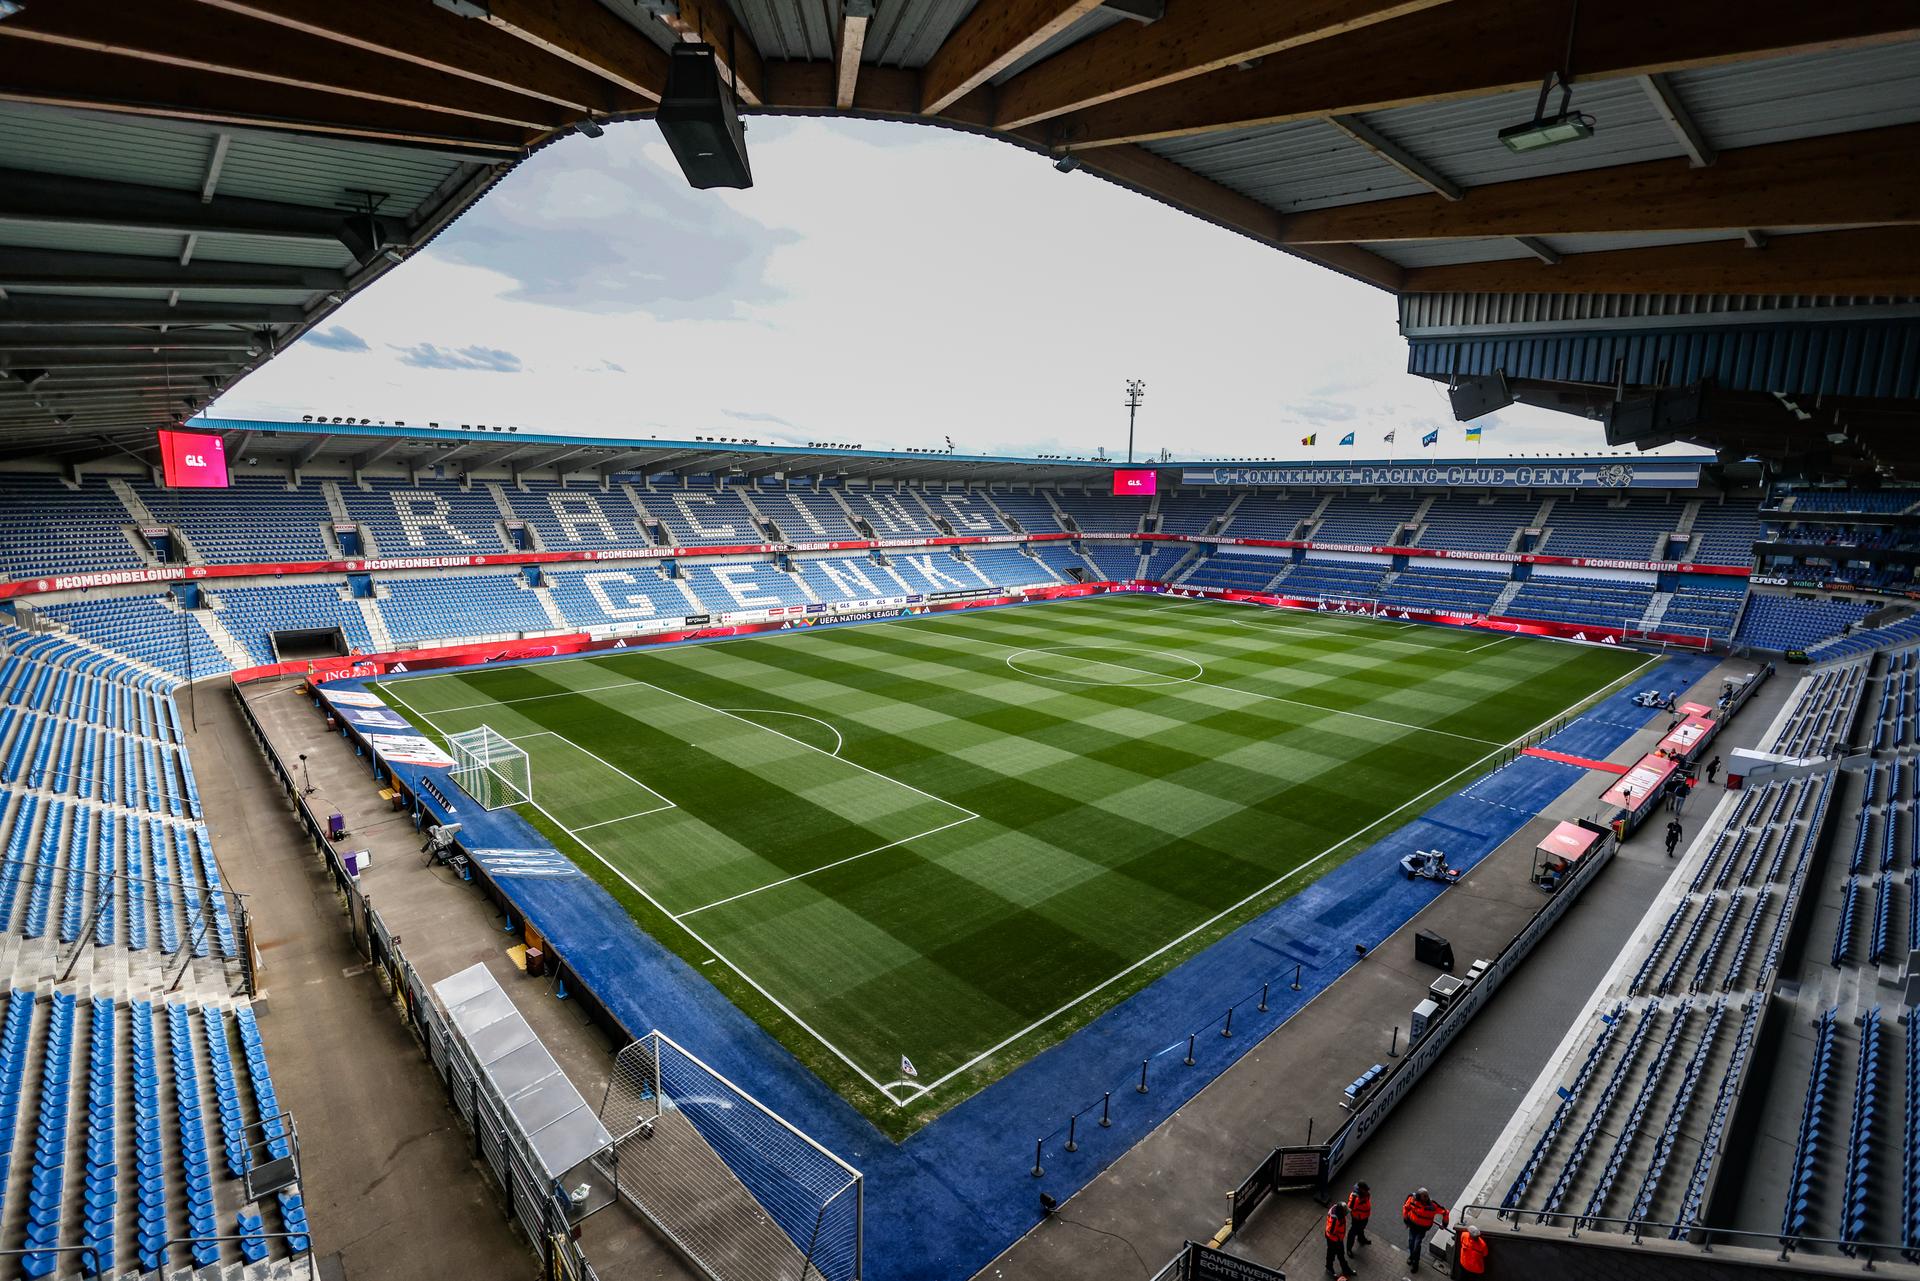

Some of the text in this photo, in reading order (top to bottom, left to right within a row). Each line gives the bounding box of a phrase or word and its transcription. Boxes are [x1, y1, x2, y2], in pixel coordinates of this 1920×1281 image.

[185, 454, 207, 467] GLS.
[1235, 467, 1585, 486] KONINKLIJKE RACING CLUB GENK
[597, 548, 675, 560] #COMEONBELGIUM
[1311, 543, 1373, 553] #COMEONBELGIUM
[1445, 550, 1522, 562] #COMEONBELGIUM
[364, 556, 470, 570] #COMEONBELGIUM
[1584, 559, 1678, 571] #COMEONBELGIUM
[55, 568, 184, 590] #COMEONBELGIUM
[1792, 580, 1816, 588] water
[820, 609, 899, 625] UEFA NATIONS LEAGUE
[325, 670, 350, 682] ING
[1356, 1095, 1394, 1140] Scoren
[1395, 1063, 1416, 1096] met
[1200, 1259, 1239, 1279] ECHTE
